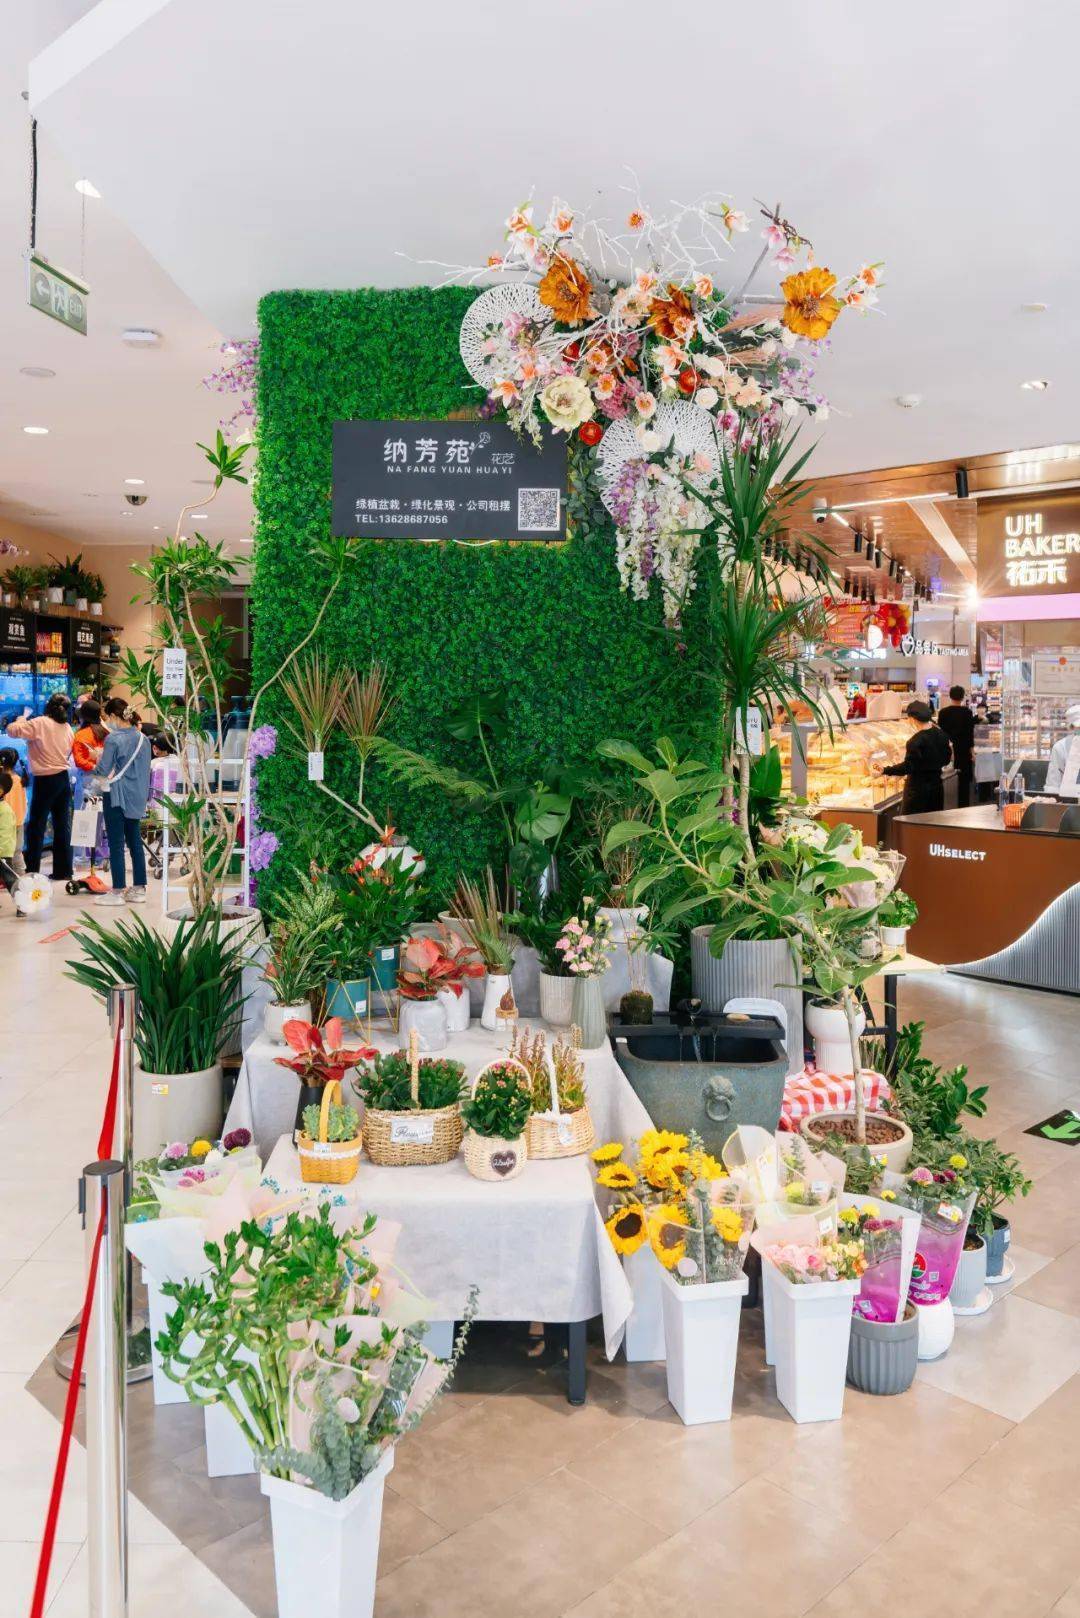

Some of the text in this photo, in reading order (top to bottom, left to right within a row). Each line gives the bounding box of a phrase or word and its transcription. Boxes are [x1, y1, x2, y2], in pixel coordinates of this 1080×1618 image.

[384, 438, 470, 463] 纳芳苑
[491, 452, 515, 465] 花艺
[387, 465, 402, 473] NA
[407, 465, 436, 473] FANG
[441, 465, 471, 474] YUAN
[1005, 512, 1042, 537] UH
[929, 843, 987, 861] UHSELECT
